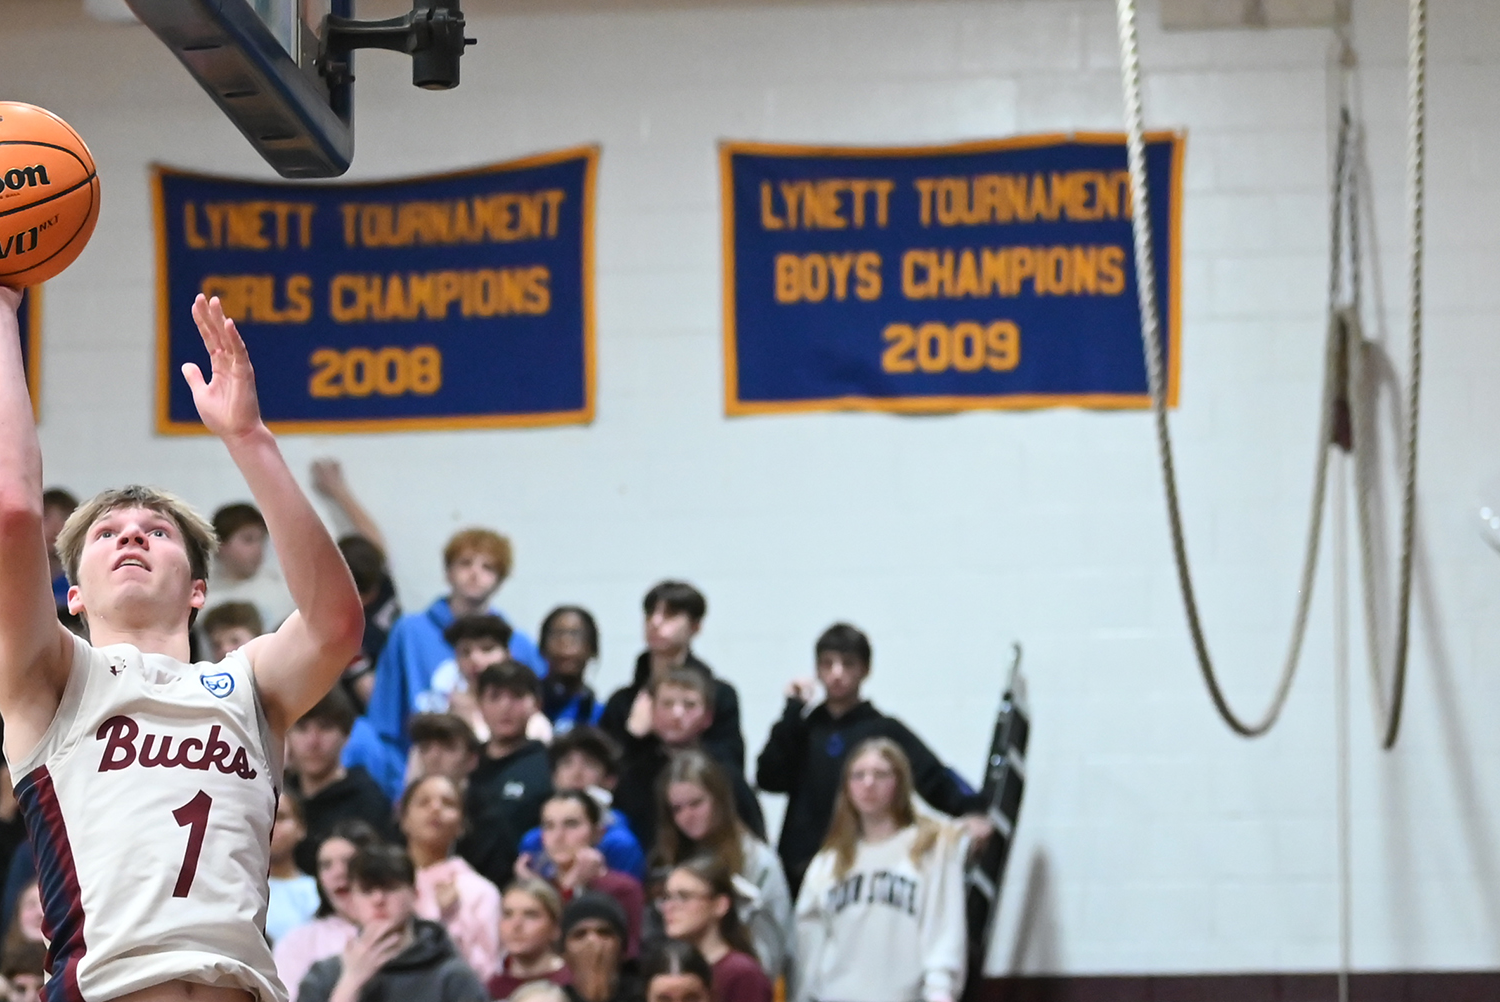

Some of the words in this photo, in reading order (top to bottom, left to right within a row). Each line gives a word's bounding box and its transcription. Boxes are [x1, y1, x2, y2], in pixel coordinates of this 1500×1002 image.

[39, 213, 59, 232] NXT
[184, 200, 315, 250] LYNETT
[341, 190, 565, 246] TOURNAMENT
[760, 180, 894, 231] LYNETT
[330, 266, 551, 323] CHAMPIONS
[774, 252, 882, 303] BOYS
[902, 246, 1126, 300] CHAMPIONS
[309, 346, 441, 397] 2008
[881, 321, 1020, 374] 2009
[96, 714, 257, 781] Bucks
[172, 789, 213, 898] 1
